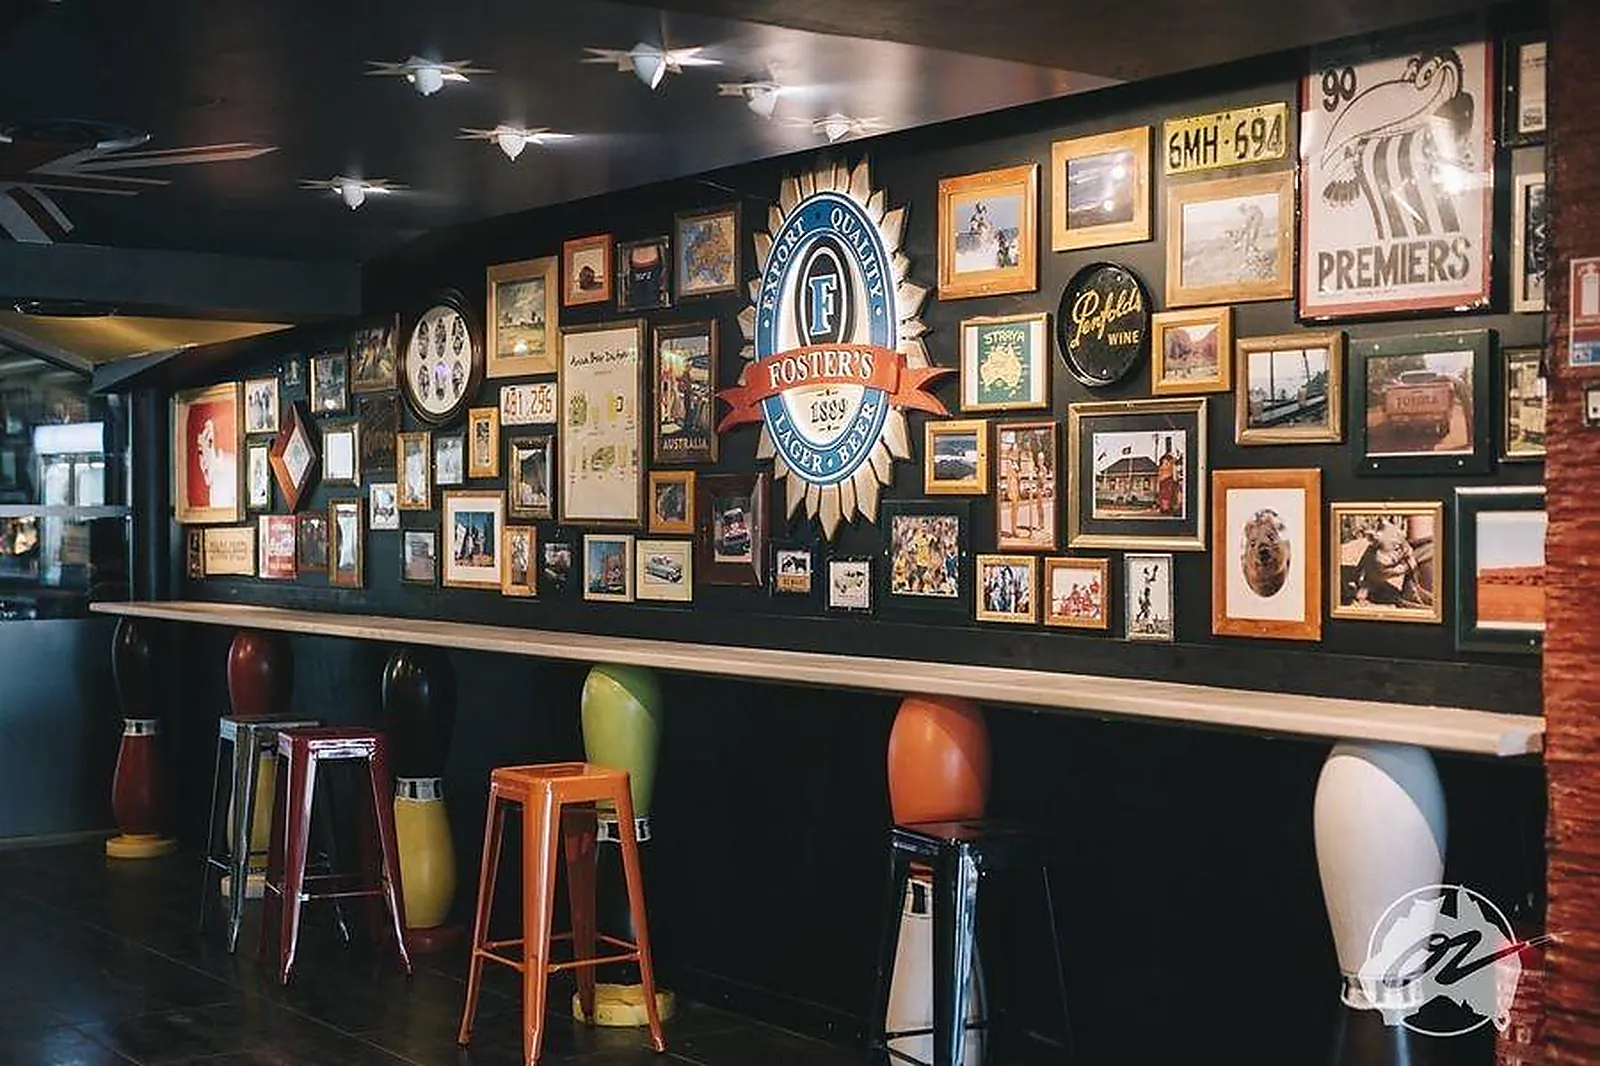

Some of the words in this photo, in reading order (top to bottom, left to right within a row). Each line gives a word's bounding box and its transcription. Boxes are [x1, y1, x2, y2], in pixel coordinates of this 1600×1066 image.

[762, 216, 806, 309] EXPORT
[830, 207, 883, 299] QUALITY
[1318, 236, 1472, 292] PREMIERS
[808, 272, 838, 336] F
[1070, 287, 1142, 350] Penfolds
[1107, 330, 1140, 346] WINE
[767, 350, 874, 390] FOSTER'S
[662, 437, 710, 451] AUSTRALIA
[775, 412, 823, 473] LAGER
[838, 401, 876, 466] BEER
